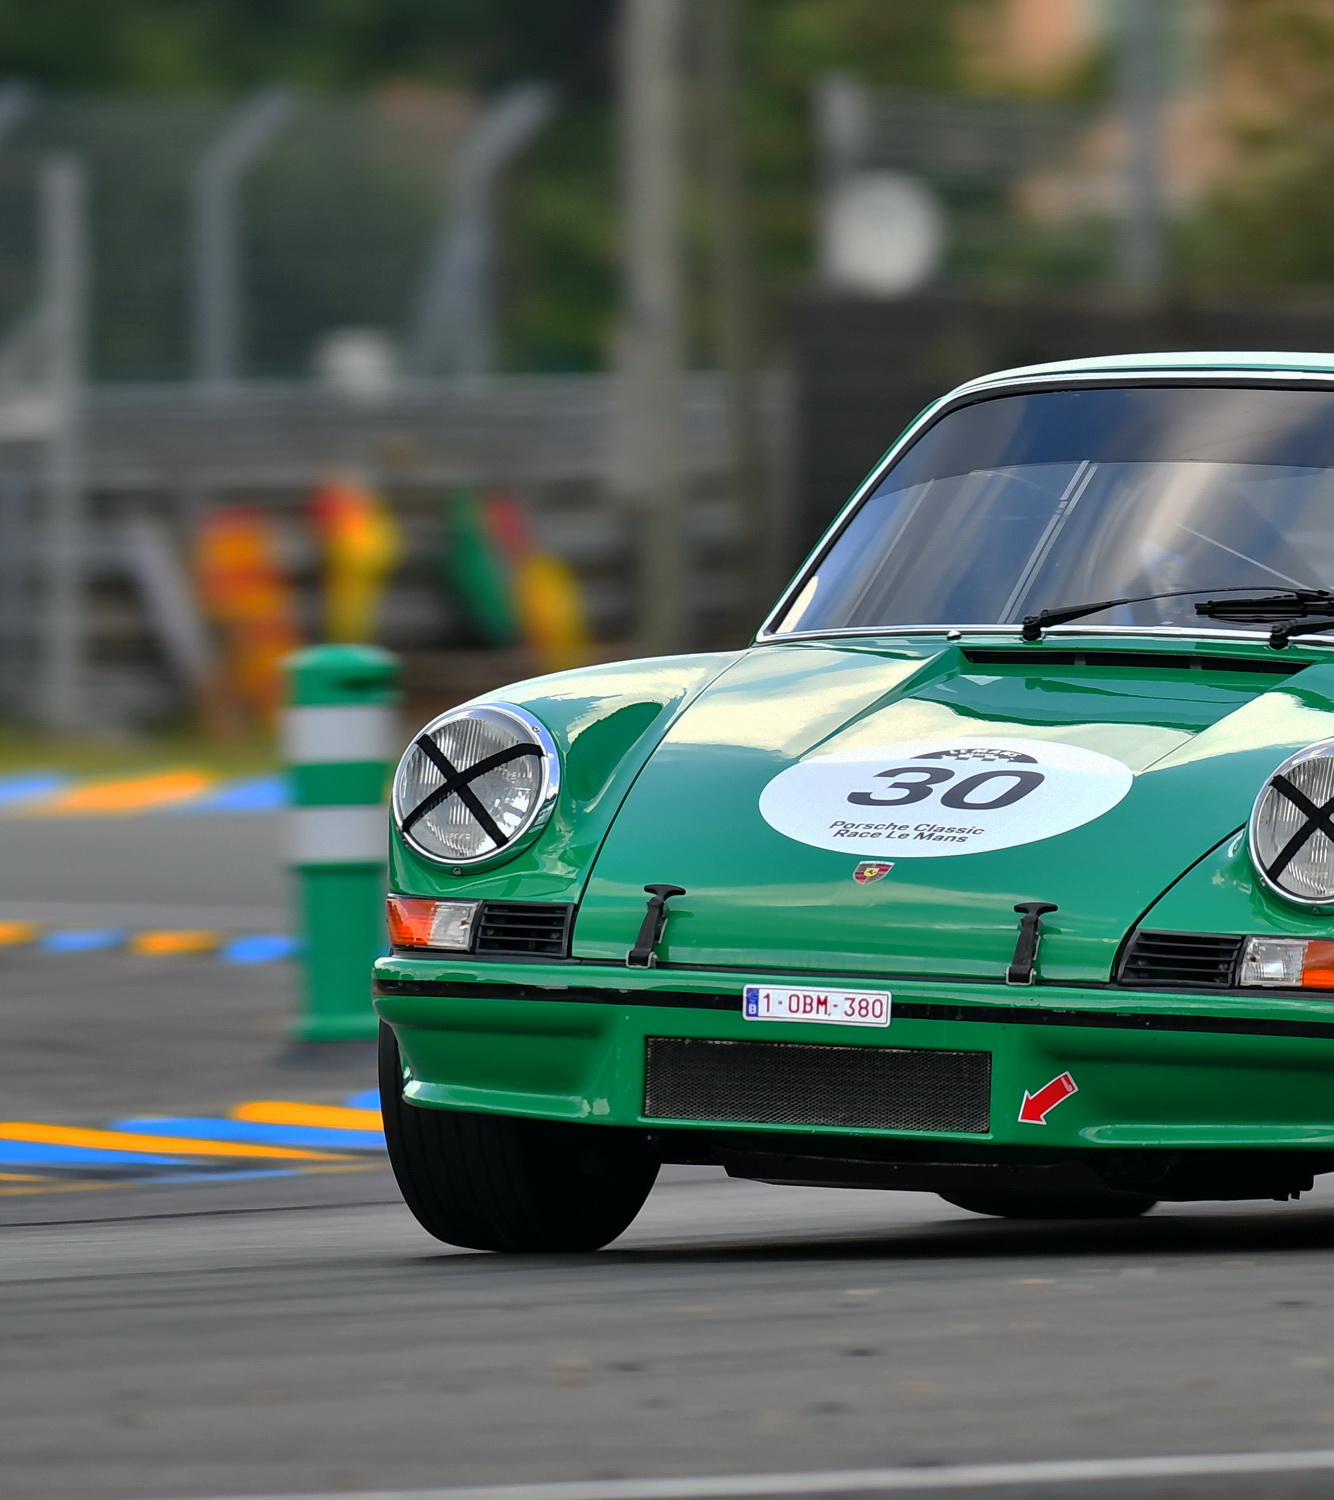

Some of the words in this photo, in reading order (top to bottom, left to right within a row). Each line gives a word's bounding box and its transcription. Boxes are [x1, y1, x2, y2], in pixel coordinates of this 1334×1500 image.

[847, 766, 1045, 810] 30
[829, 820, 909, 831] Porsche
[913, 823, 985, 835] Classic
[832, 829, 882, 838] Race
[885, 830, 909, 839] Le
[913, 832, 968, 843] Mans
